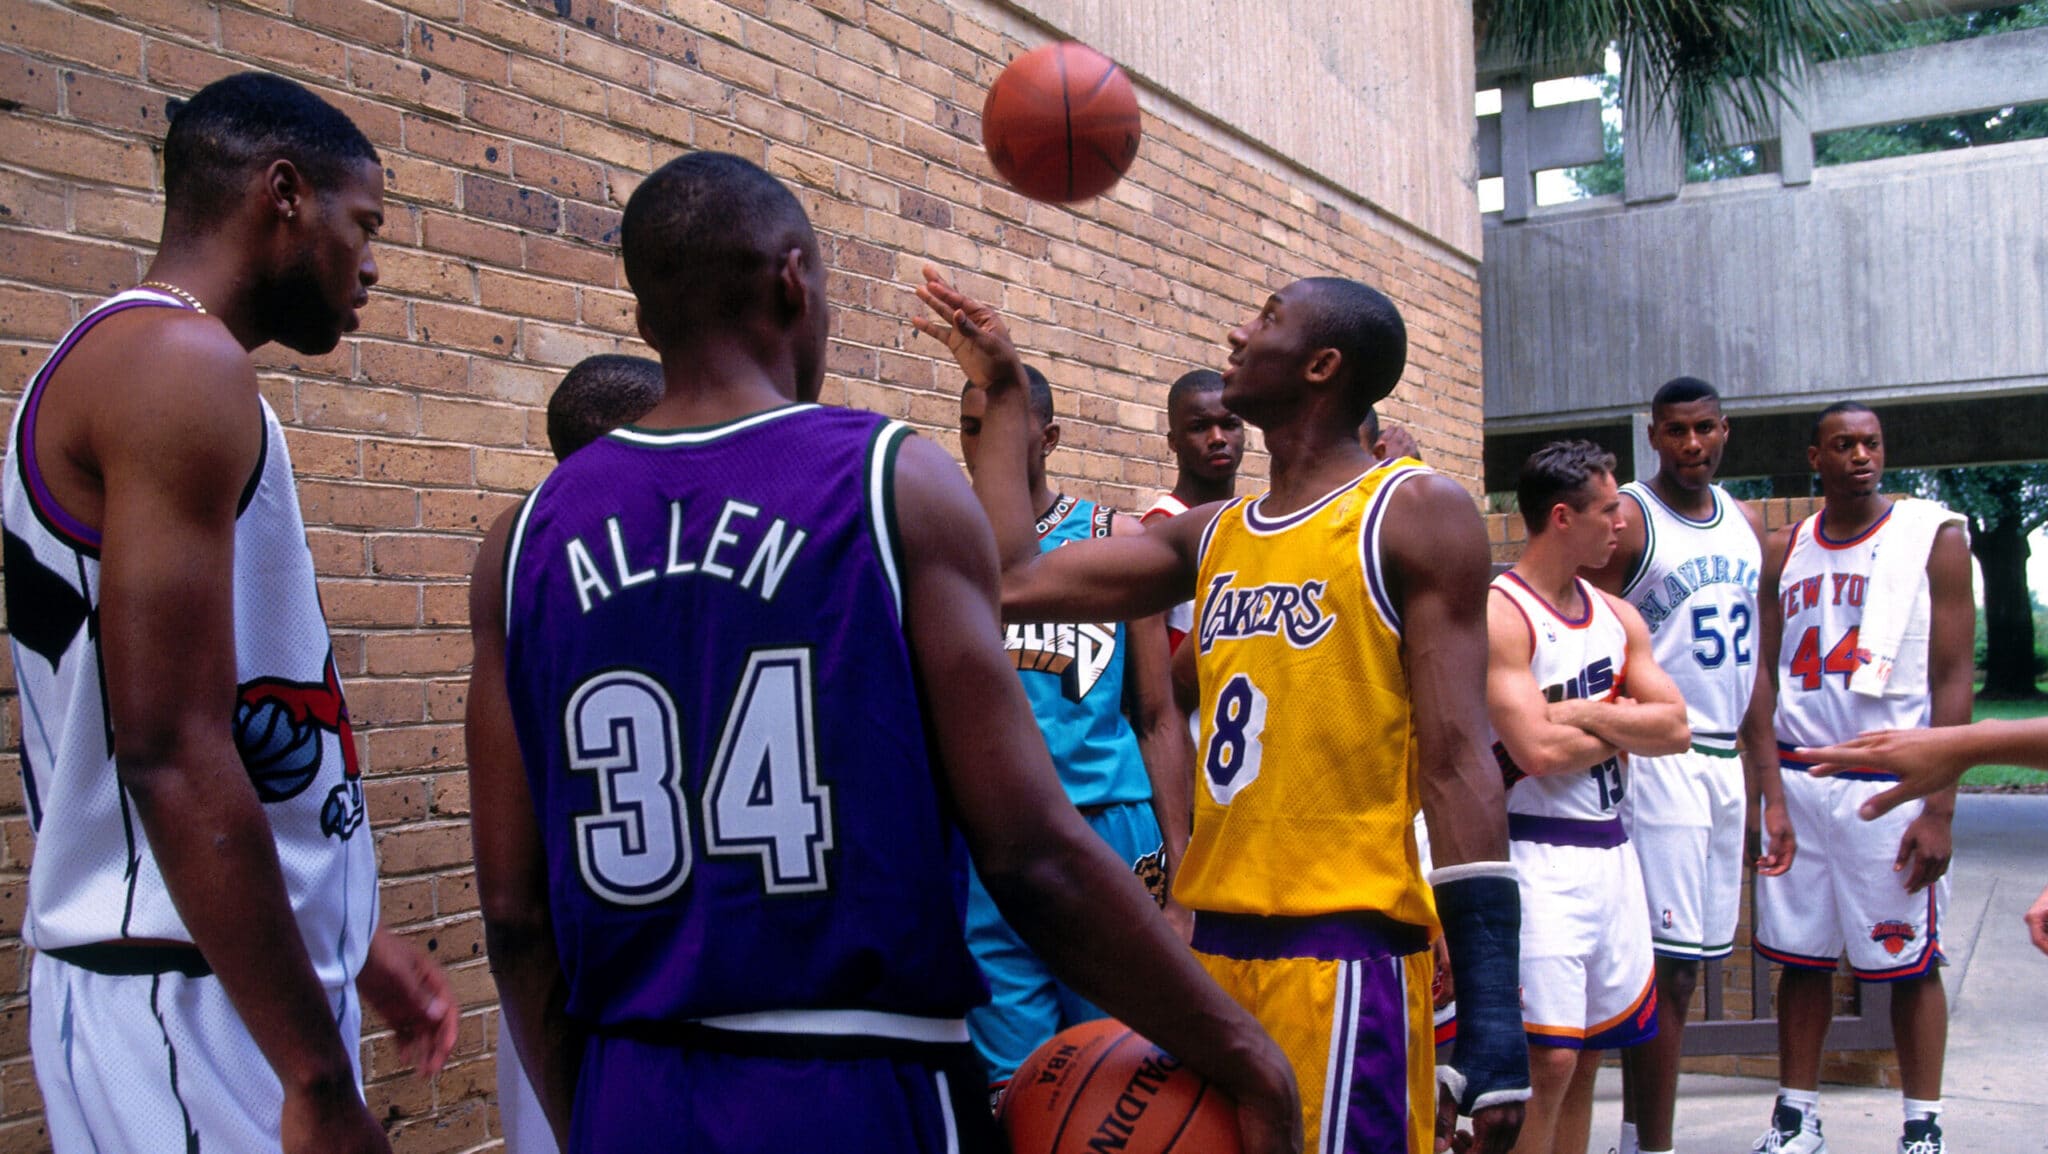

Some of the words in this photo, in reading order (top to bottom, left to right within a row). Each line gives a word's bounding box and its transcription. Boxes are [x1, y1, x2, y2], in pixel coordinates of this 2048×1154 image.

[566, 500, 806, 613] ALLEN
[1832, 572, 1870, 607] YO
[1200, 570, 1337, 655] LAKERS
[1691, 603, 1752, 670] 52
[1790, 626, 1860, 691] 44
[1205, 673, 1267, 804] 8
[565, 647, 834, 906] 34
[1591, 755, 1624, 810] 13
[1038, 1045, 1077, 1083] NBA
